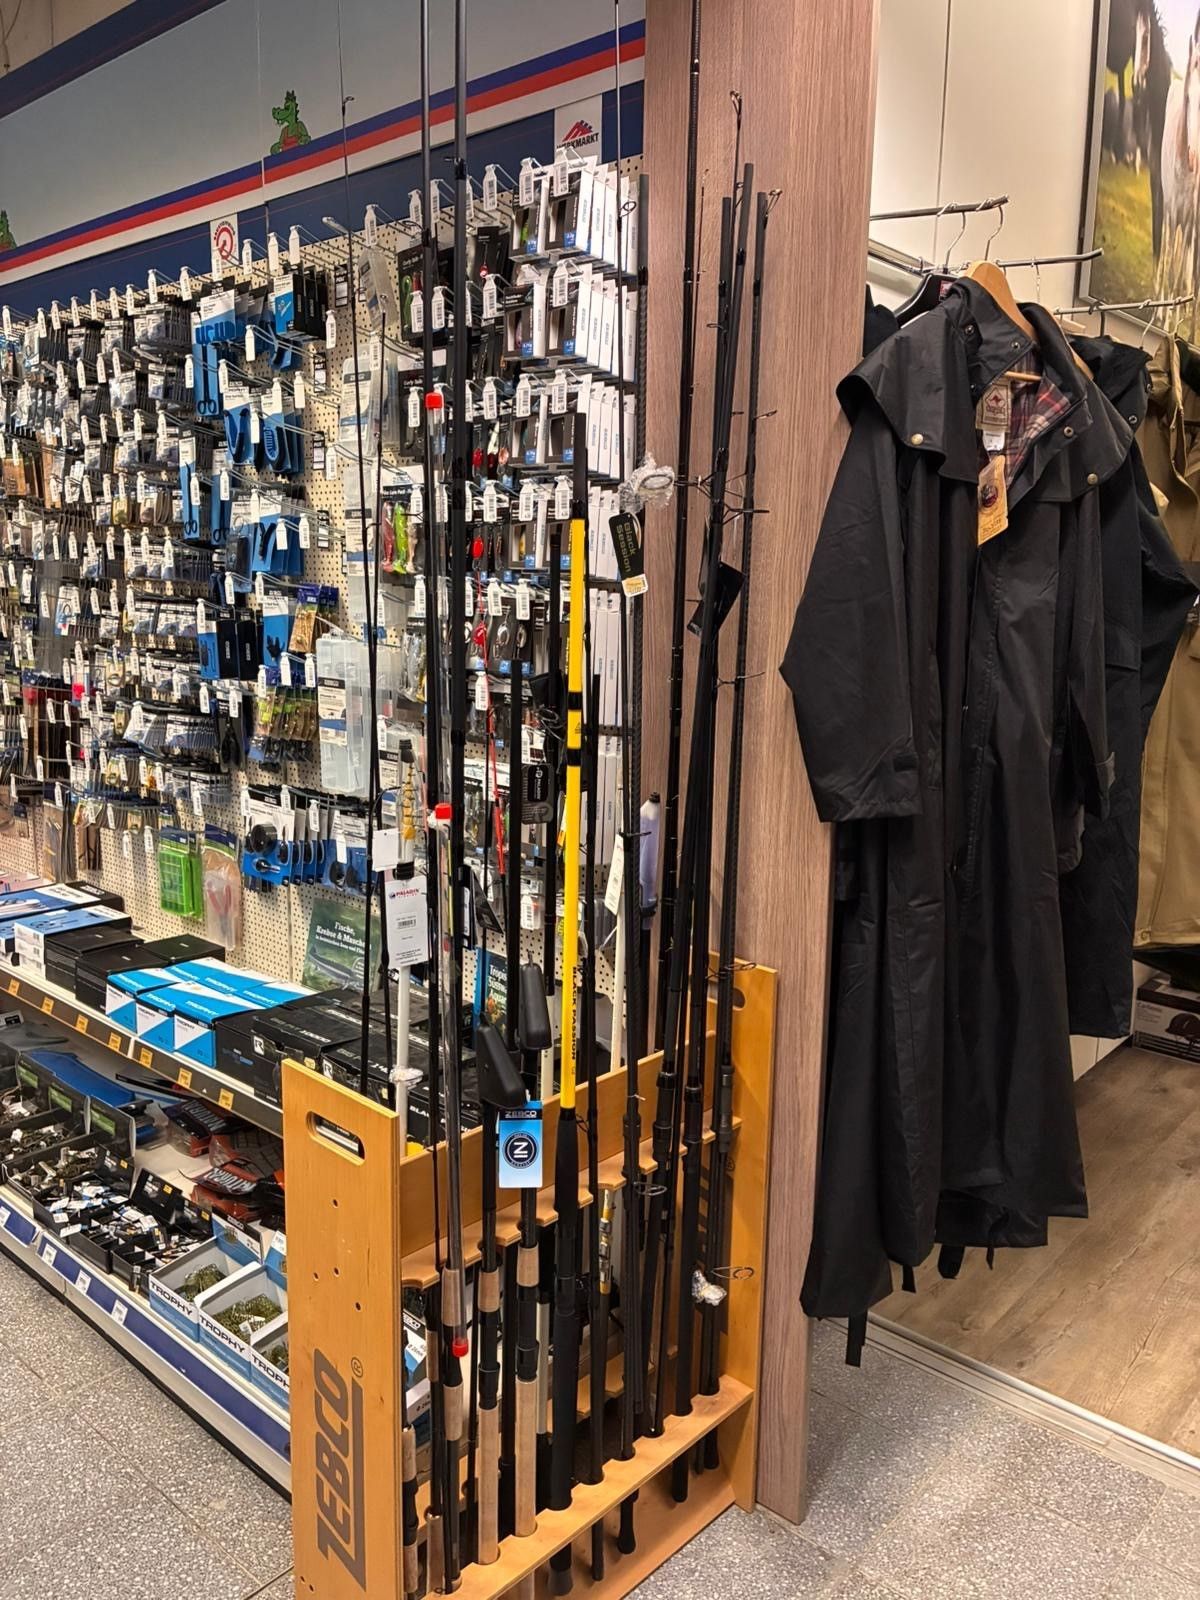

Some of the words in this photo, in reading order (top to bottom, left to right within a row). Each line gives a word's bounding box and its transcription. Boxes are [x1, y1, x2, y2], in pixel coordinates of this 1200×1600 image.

[615, 524, 633, 573] Session
[623, 522, 637, 556] Black
[409, 1105, 430, 1118] BLA
[504, 1110, 538, 1119] ZEBCO
[150, 1281, 193, 1316] TROPHY
[200, 1315, 246, 1353] TROPHY
[252, 1354, 290, 1388] TROPH
[313, 1347, 367, 1593] ZEBCO
